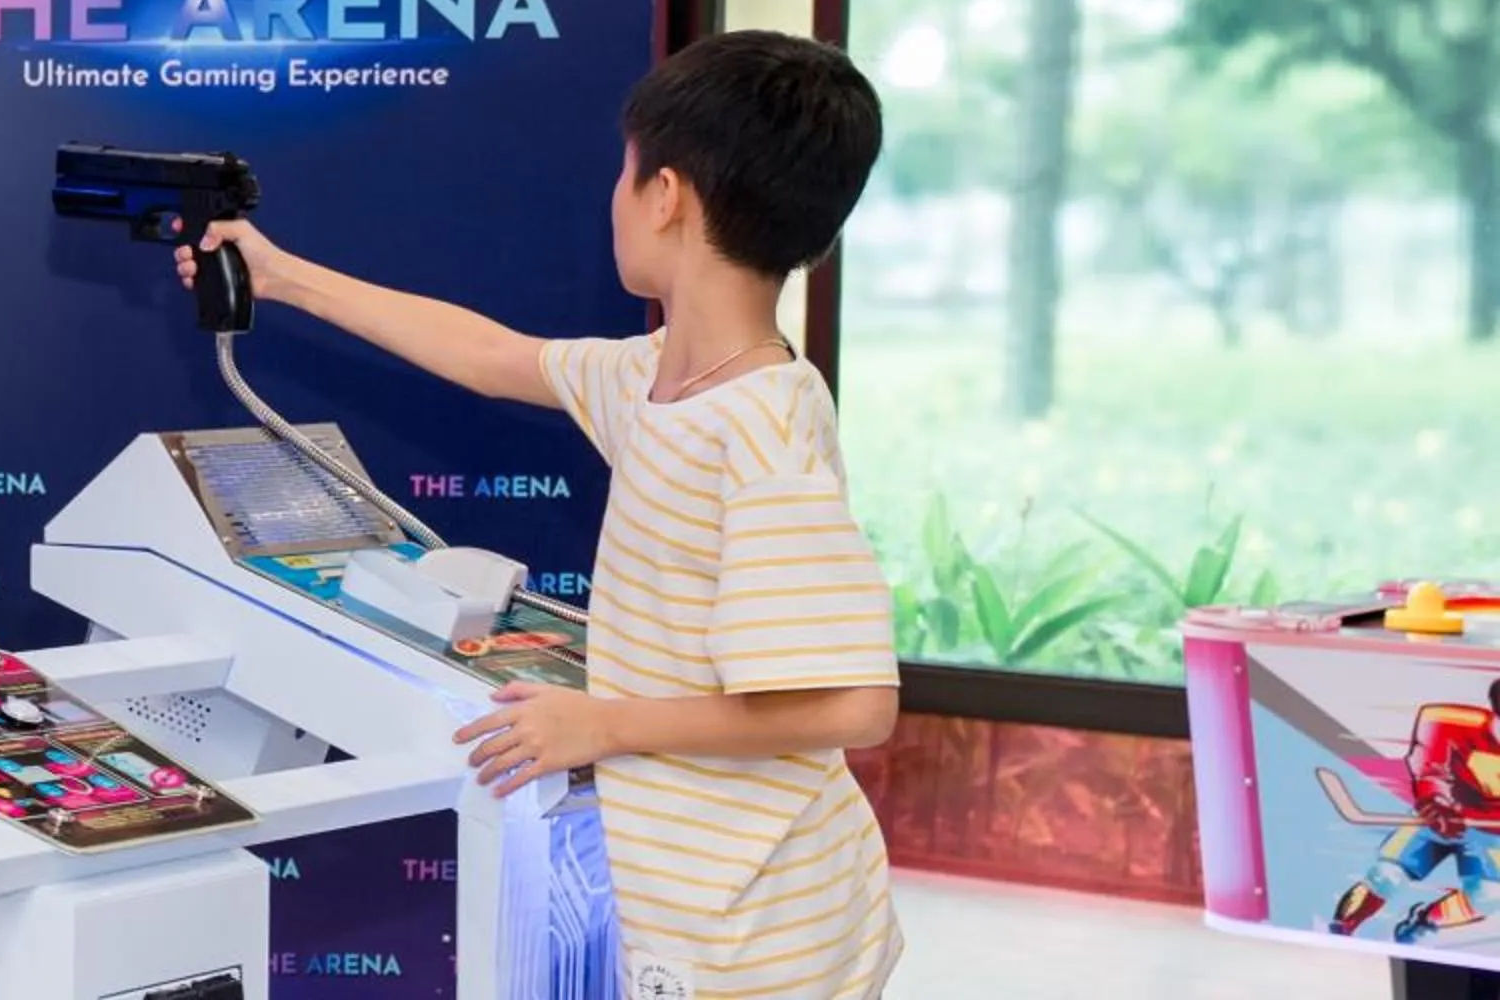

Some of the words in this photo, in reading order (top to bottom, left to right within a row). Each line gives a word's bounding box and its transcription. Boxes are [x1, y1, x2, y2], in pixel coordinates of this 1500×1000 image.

[23, 60, 149, 87] Ultimate
[160, 60, 276, 91] Gaming
[288, 60, 450, 92] Experience
[409, 473, 465, 498] THE
[474, 474, 571, 499] ARENA
[527, 572, 593, 595] AREN
[402, 857, 457, 882] THE
[306, 952, 402, 976] ARENA
